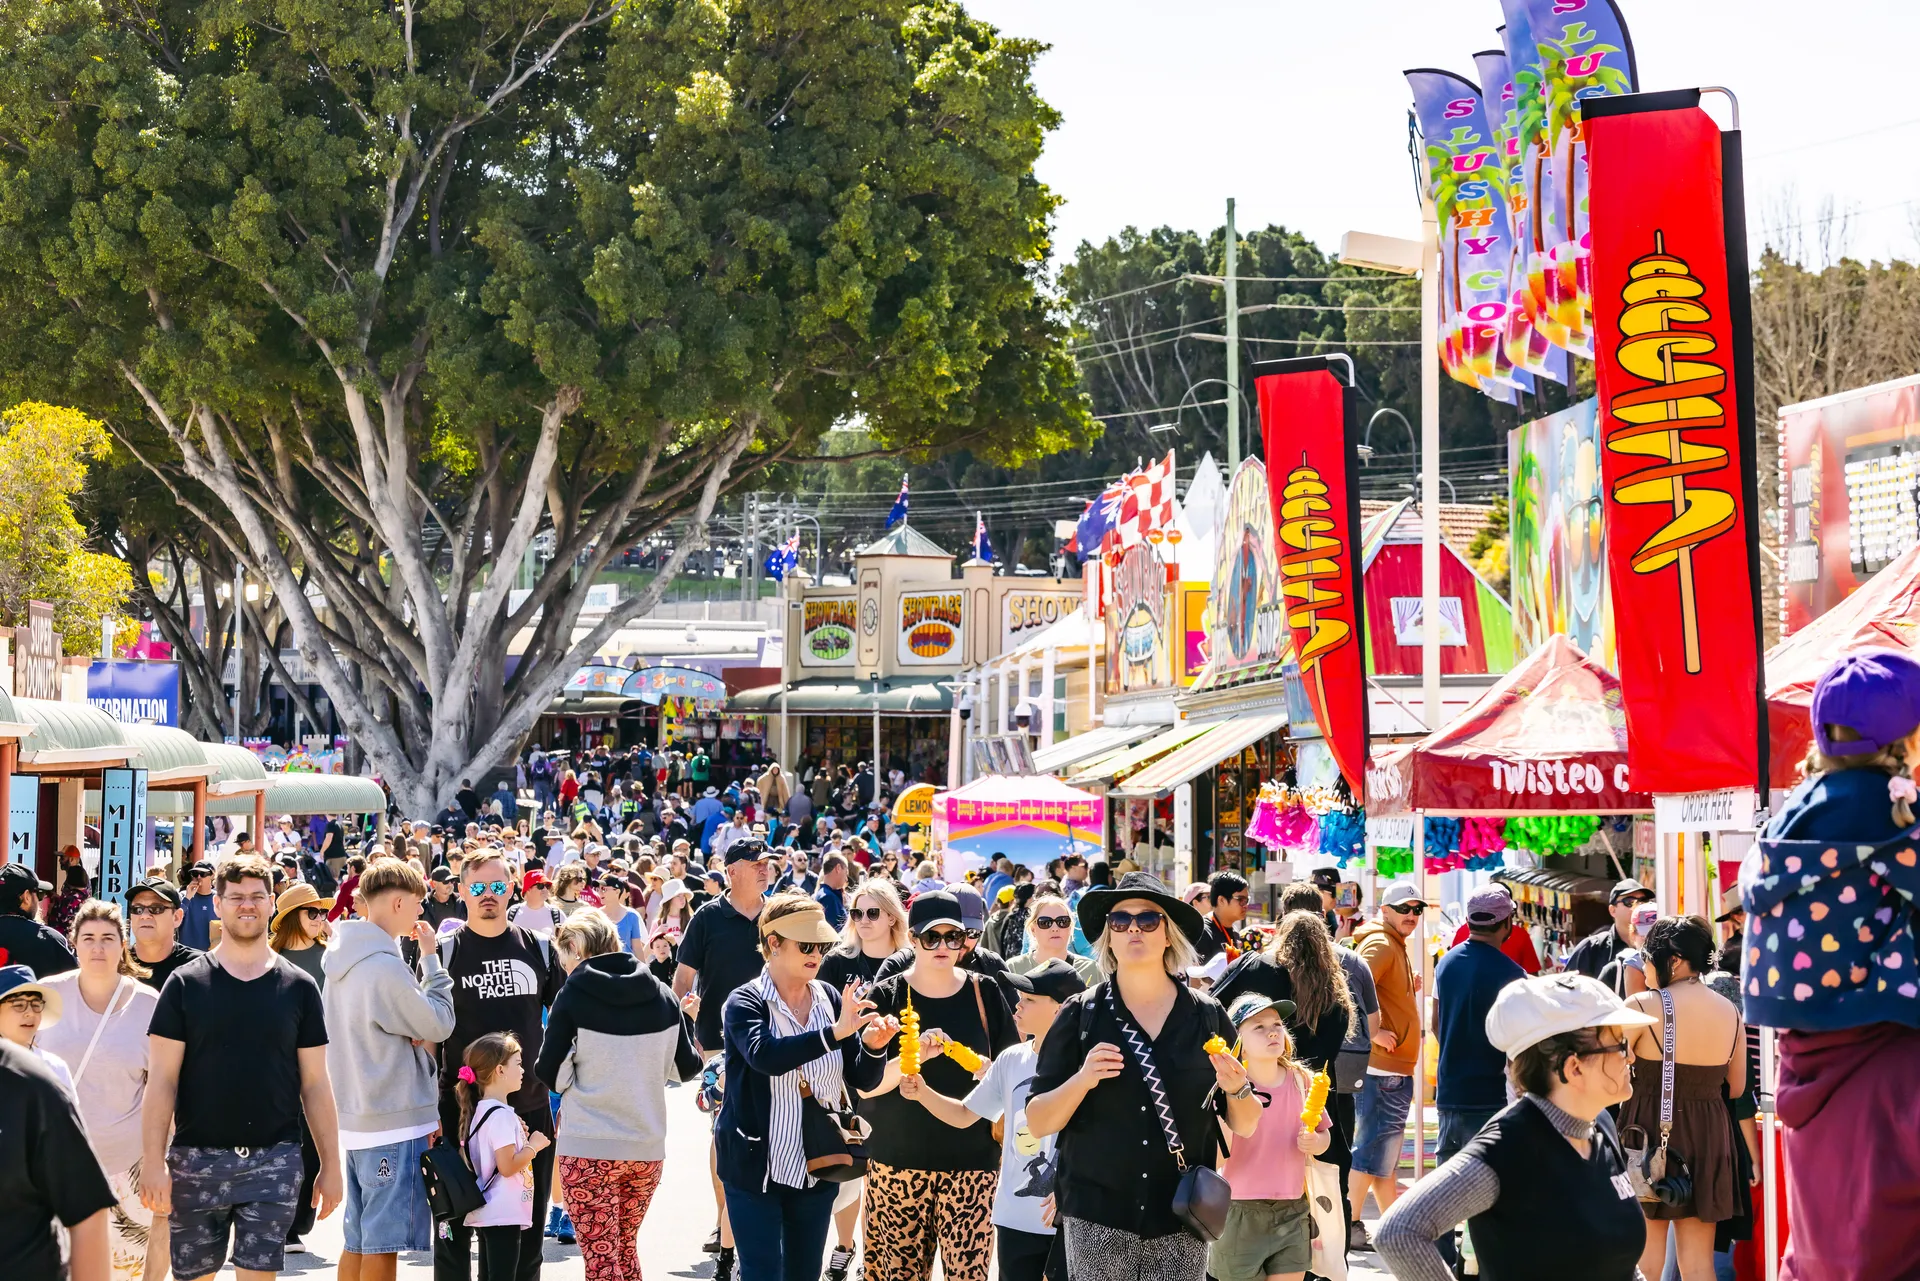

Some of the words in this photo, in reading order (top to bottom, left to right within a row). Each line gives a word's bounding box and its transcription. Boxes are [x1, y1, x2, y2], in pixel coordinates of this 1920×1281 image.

[1443, 97, 1499, 256] SLUSHY
[804, 600, 857, 635] SHOWBAGS
[902, 594, 962, 632] SHOWBAGS
[1009, 595, 1083, 632] SHOW
[31, 614, 53, 657] SUPER
[1257, 608, 1281, 656] SHOP
[27, 656, 56, 700] DONUTS
[87, 698, 168, 724] FORMATION
[983, 806, 1015, 815] POPCORN
[1021, 806, 1041, 815] FAIRY
[1042, 806, 1063, 815] FLOSS
[1681, 793, 1710, 823] ORDER
[1709, 791, 1734, 821] HERE
[136, 804, 144, 885] FREA
[461, 971, 513, 989] NORTH
[481, 958, 511, 973] THE
[478, 984, 515, 1000] FACE
[1665, 1022, 1674, 1053] GUESS
[1664, 1060, 1673, 1091] GUESS
